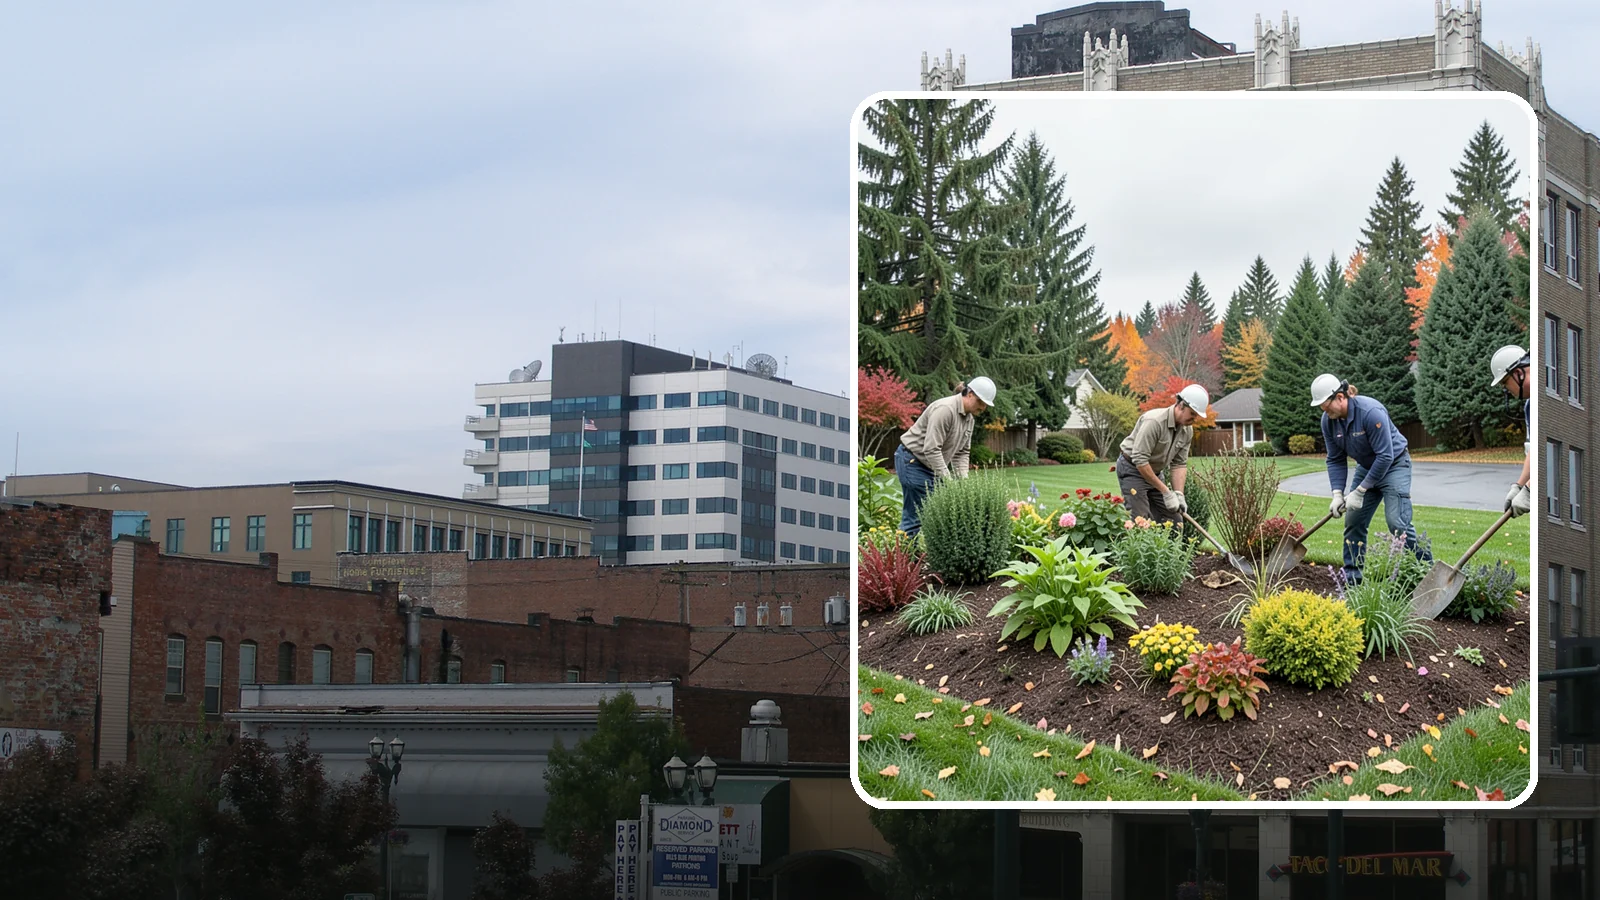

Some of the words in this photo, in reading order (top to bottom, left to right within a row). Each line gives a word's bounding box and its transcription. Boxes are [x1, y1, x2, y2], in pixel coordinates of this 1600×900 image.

[370, 566, 427, 577] Furnishers
[660, 818, 713, 832] DIAMOND
[1022, 814, 1070, 827] BUILDING
[719, 824, 740, 835] ETT
[617, 825, 625, 852] PAY
[628, 825, 637, 852] PAY
[722, 852, 739, 862] Soup
[671, 862, 701, 870] PATRONS
[1345, 856, 1385, 875] DEL
[1392, 857, 1442, 877] MAR
[616, 855, 625, 894] HERE
[627, 855, 636, 893] HERE
[660, 889, 682, 897] PUBLIC
[684, 890, 710, 898] PARKING
